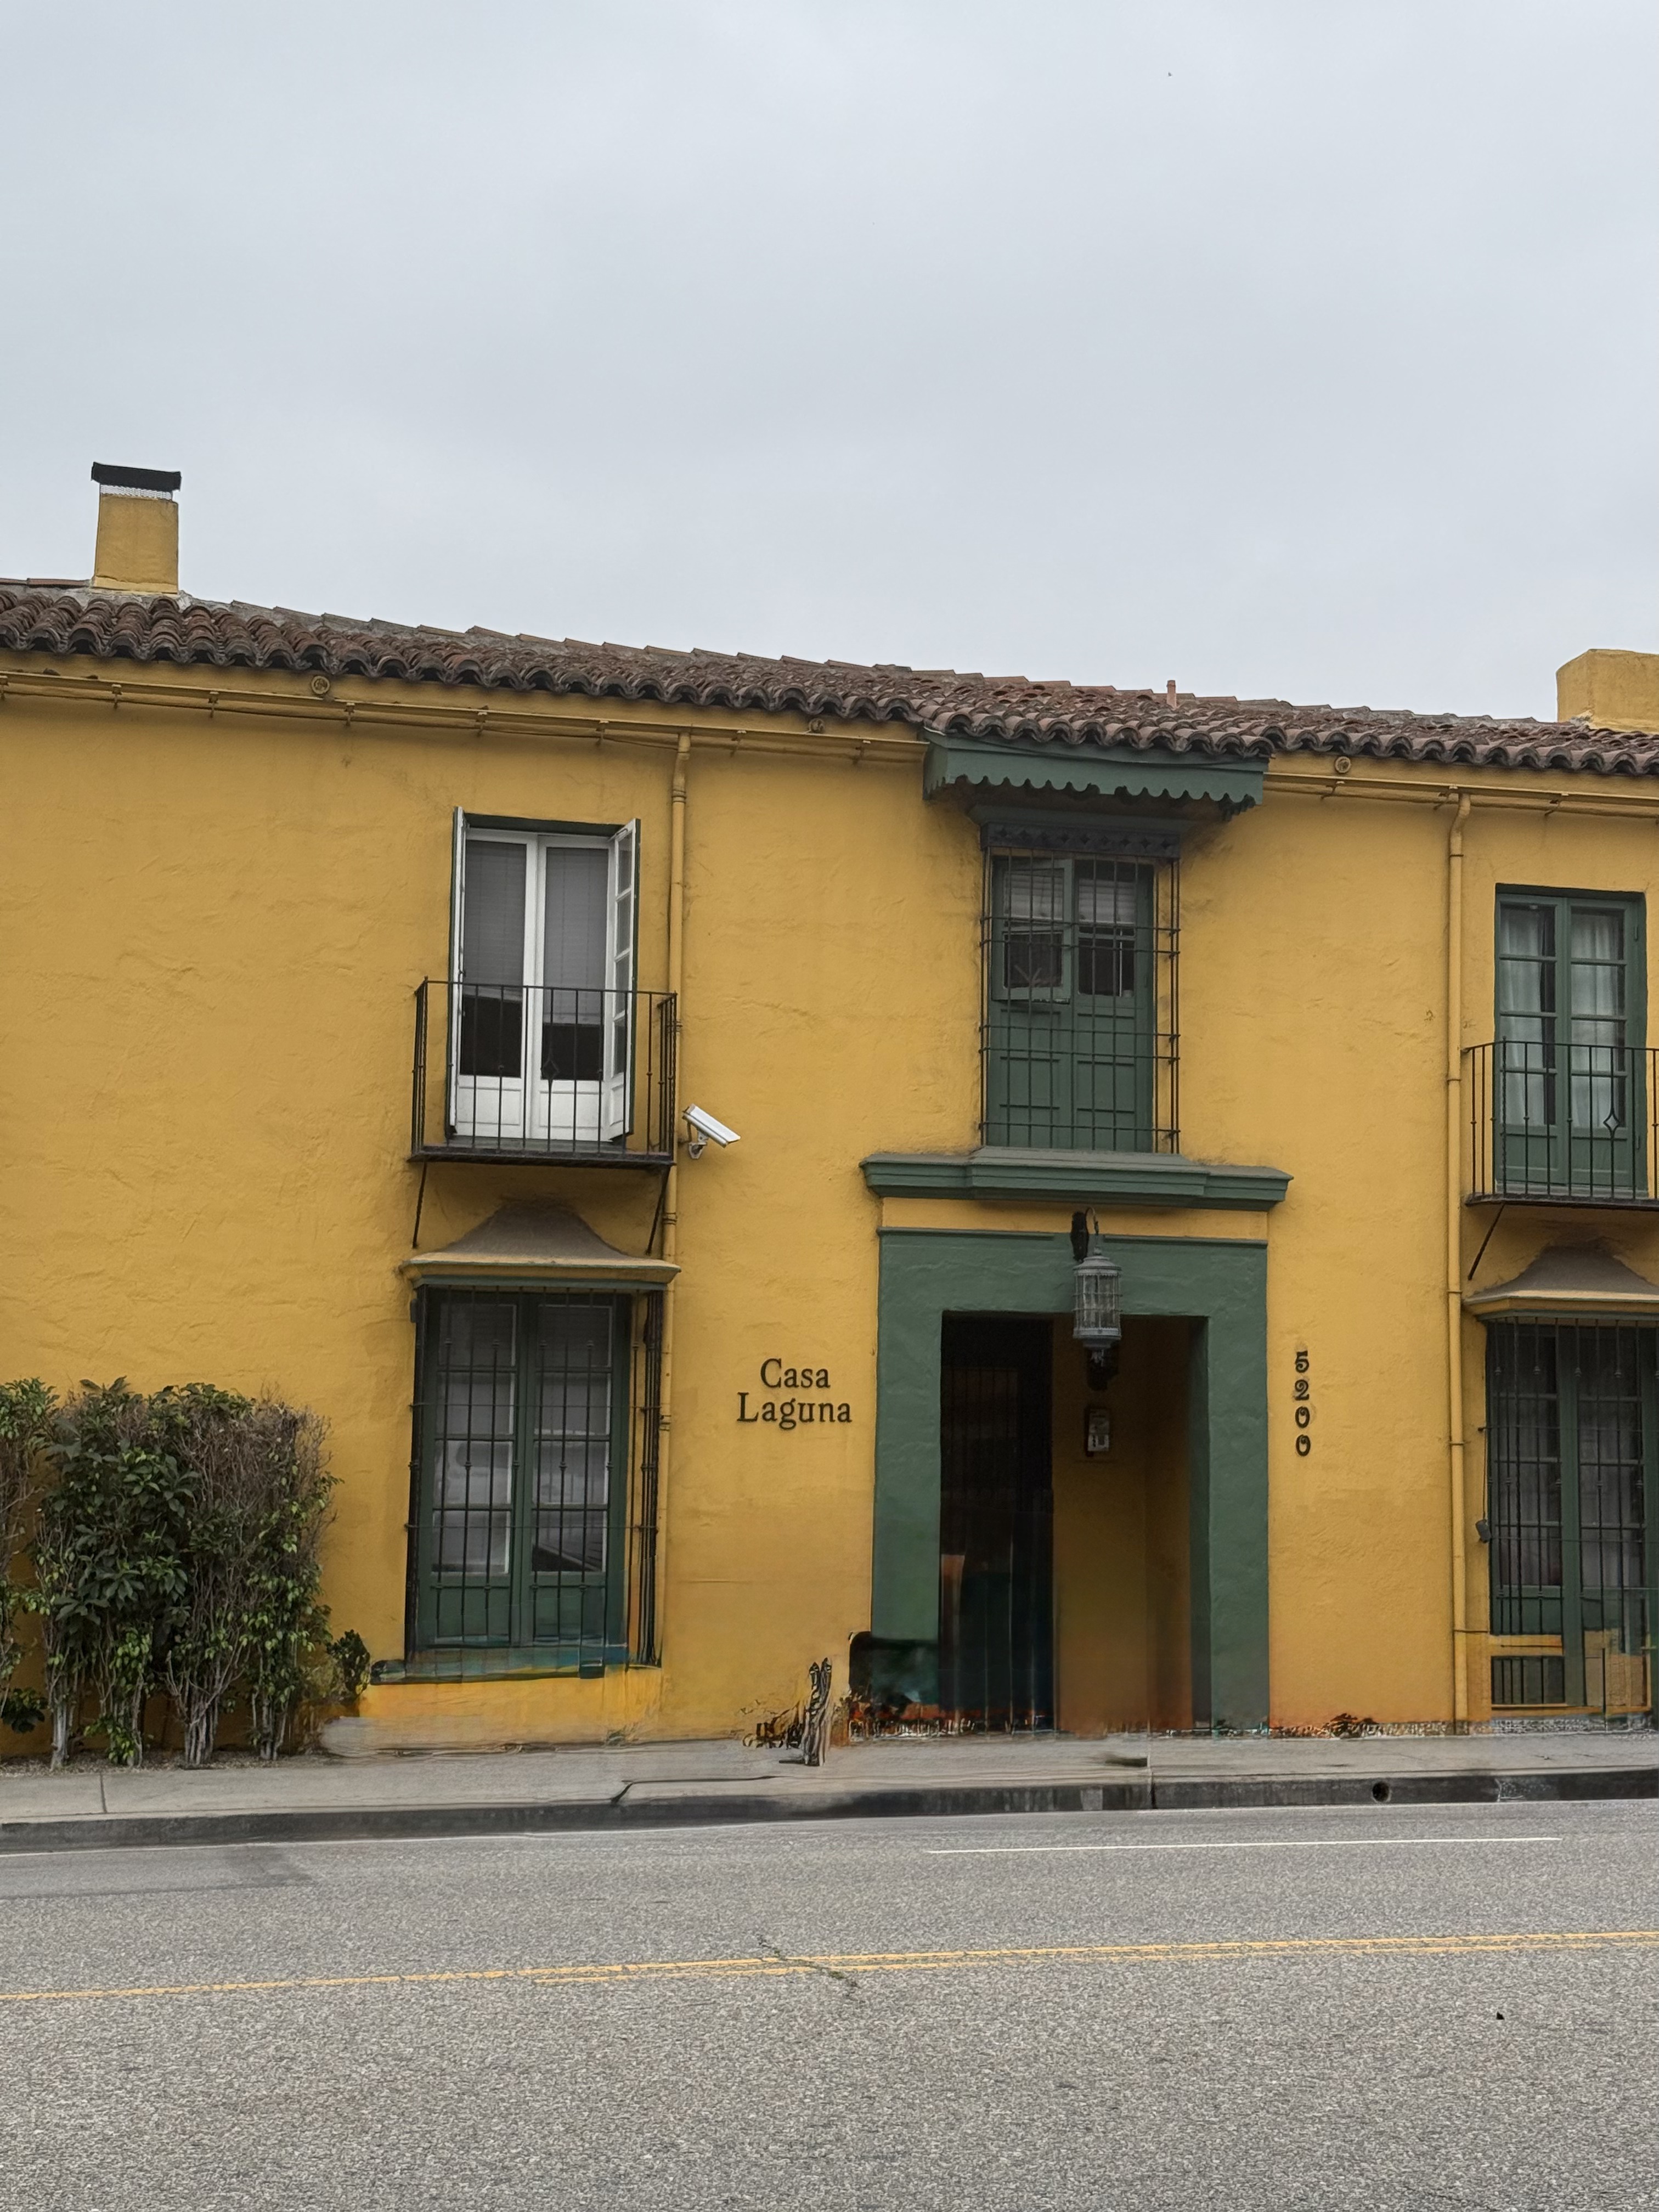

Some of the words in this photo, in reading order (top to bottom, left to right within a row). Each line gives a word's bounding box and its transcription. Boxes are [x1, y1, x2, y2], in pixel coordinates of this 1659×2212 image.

[761, 1358, 831, 1389] Casa
[737, 1392, 852, 1430] Laguna
[1295, 1351, 1311, 1457] 5200
